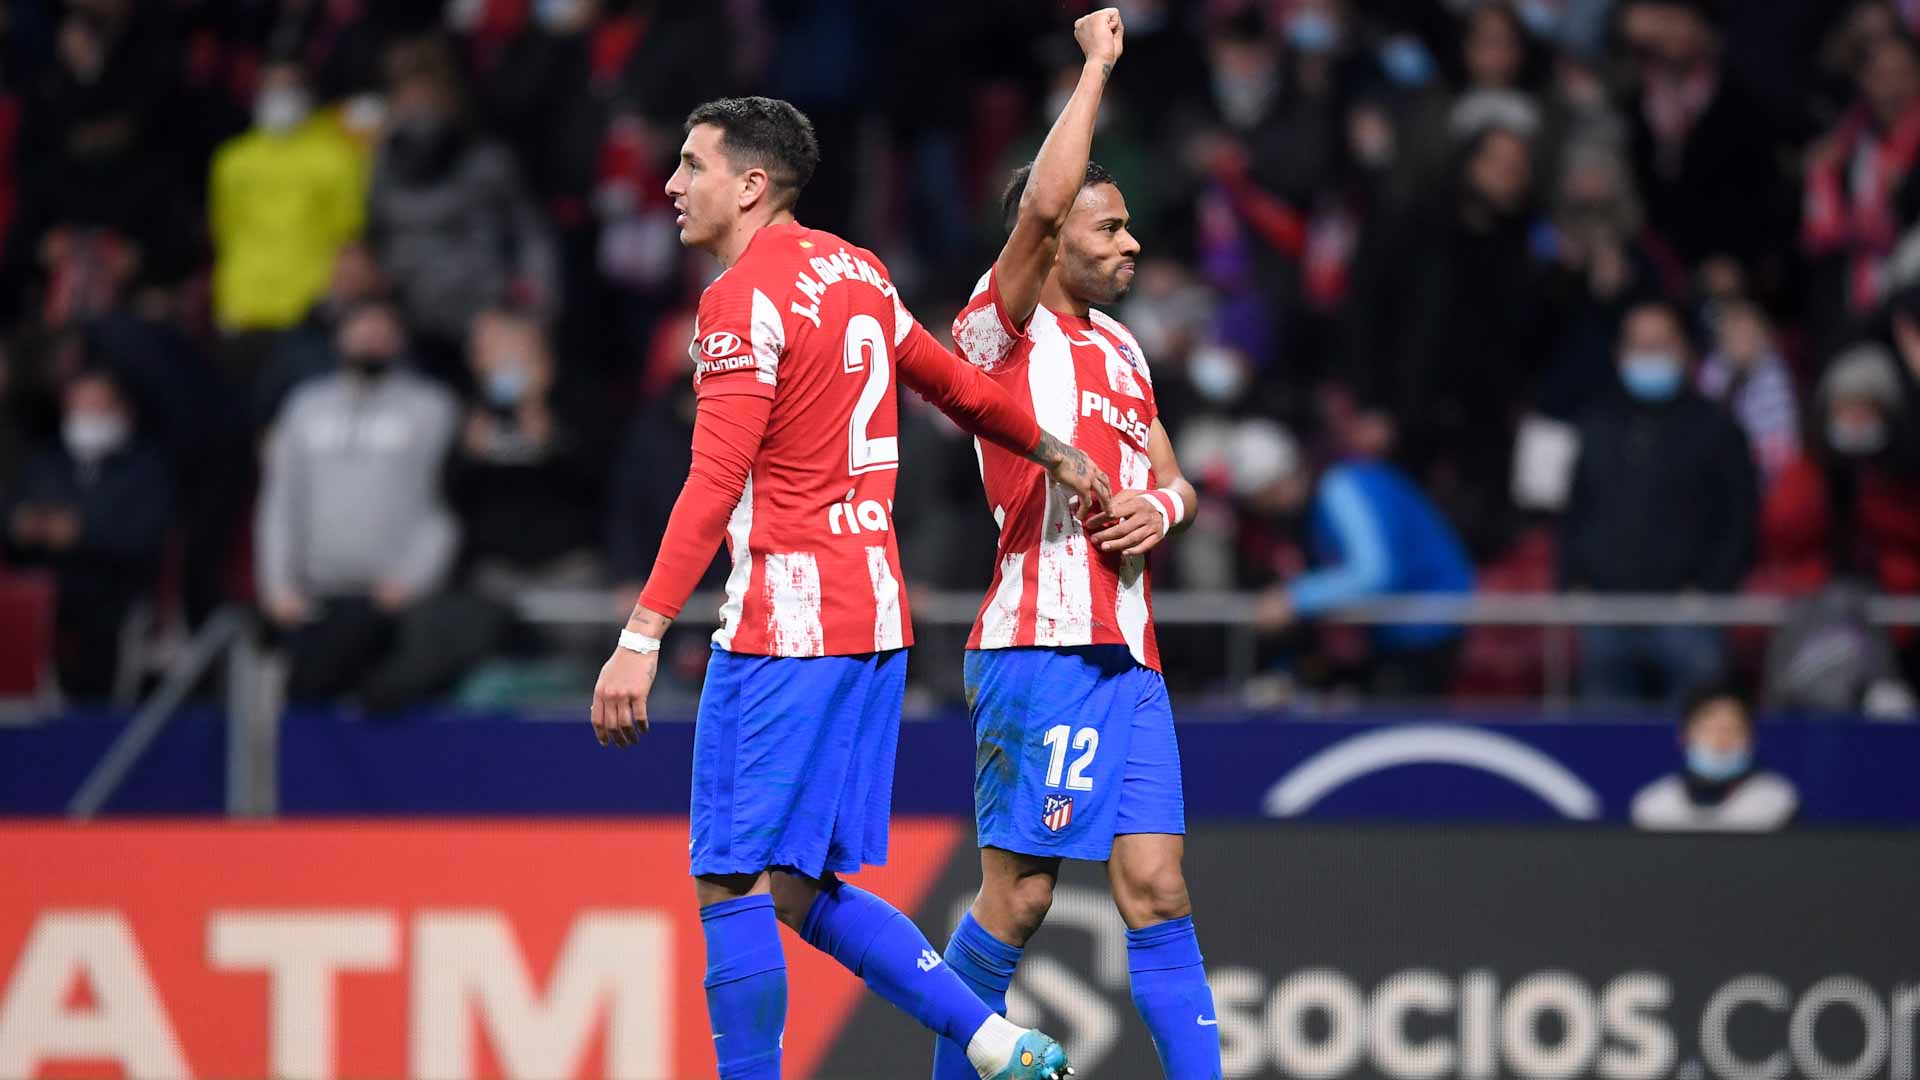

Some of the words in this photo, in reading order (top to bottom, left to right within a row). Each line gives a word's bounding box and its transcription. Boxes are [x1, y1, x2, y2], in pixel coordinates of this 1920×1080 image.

[844, 314, 898, 477] 2
[828, 488, 893, 535] ria
[1043, 724, 1099, 791] 12
[0, 909, 673, 1080] ATM
